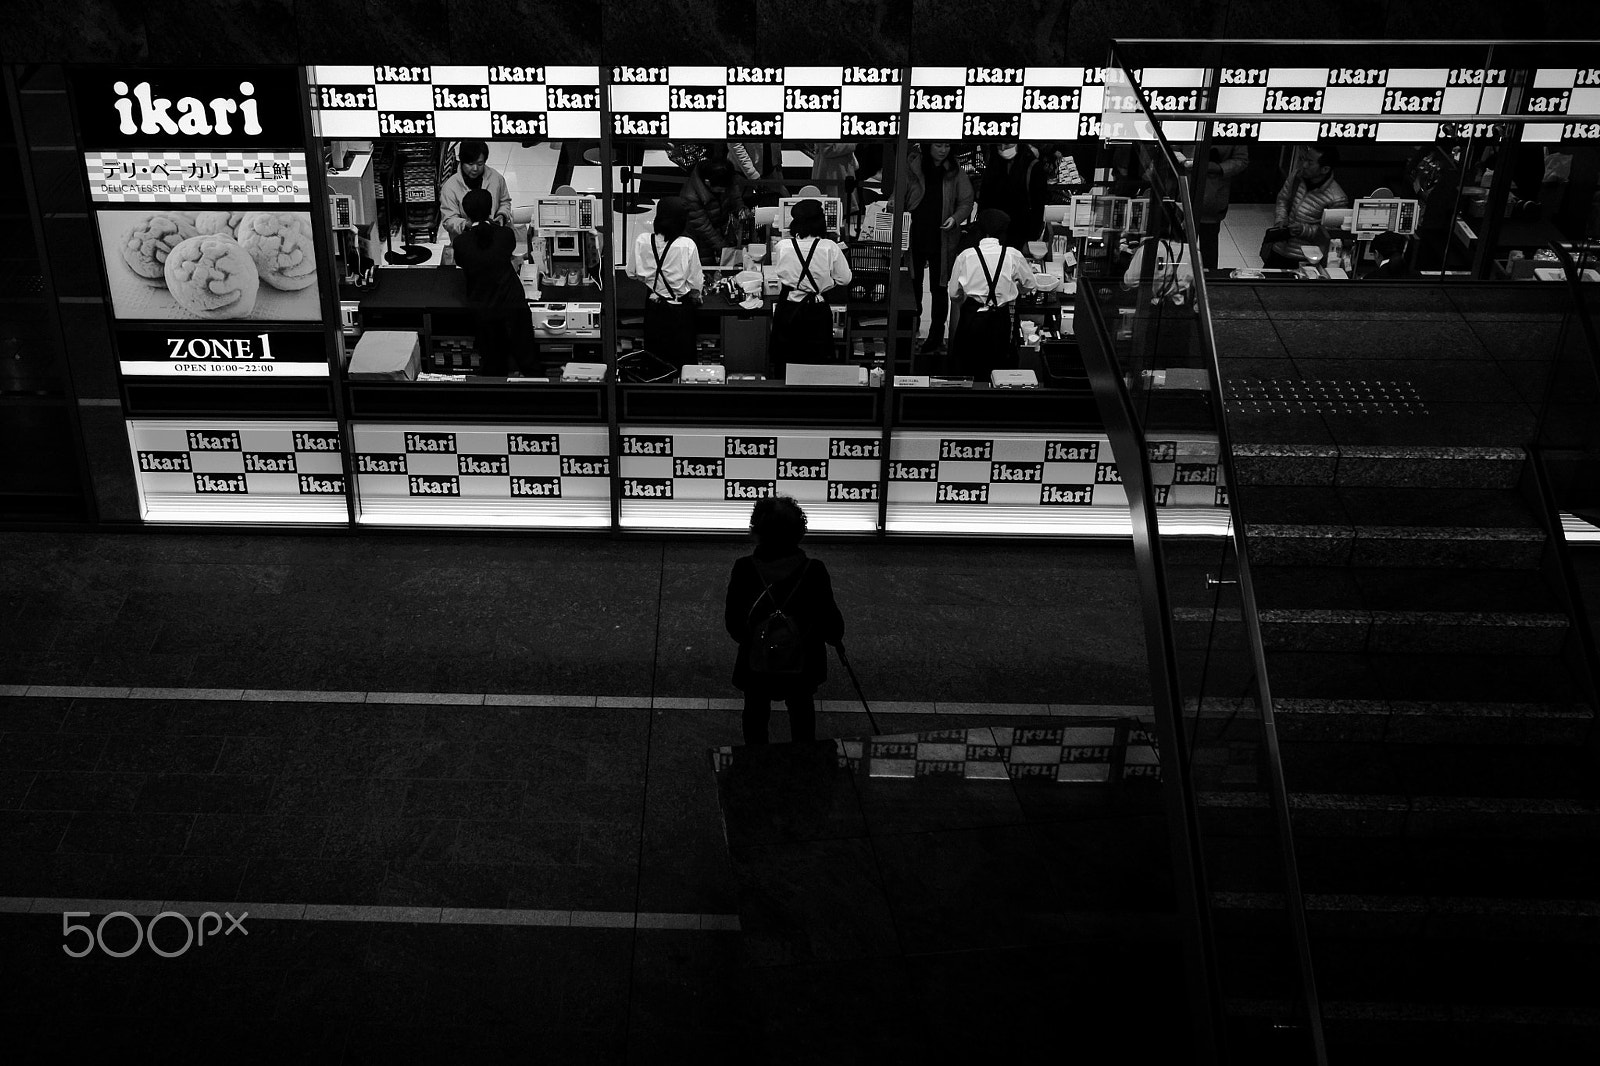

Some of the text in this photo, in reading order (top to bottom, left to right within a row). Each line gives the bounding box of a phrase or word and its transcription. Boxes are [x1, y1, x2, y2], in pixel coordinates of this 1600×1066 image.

[113, 81, 262, 135] ikari
[321, 88, 376, 108] ikari
[434, 88, 489, 109] ikari
[670, 89, 840, 109] ikari ikari
[909, 89, 1080, 110] ikari ikari
[1266, 90, 1442, 111] ikari ikari
[380, 114, 547, 135] ikari ikari
[614, 115, 897, 135] ikari ikari ikari
[964, 115, 1019, 136] ikari
[101, 184, 171, 193] DELICATESSEN
[181, 184, 218, 193] BAKERY
[229, 185, 259, 193] FRESH
[263, 185, 299, 193] FOODS
[167, 333, 276, 360] ZONE 1
[174, 363, 207, 372] OPEN
[190, 432, 240, 450] ikari
[408, 434, 558, 453] ikari ikari
[623, 437, 880, 457] ikari ikari ikari
[942, 441, 1097, 461] ikari ikari
[140, 453, 295, 471] ikari ikari
[358, 455, 610, 475] ikari ikari ikari
[675, 459, 827, 478] ikari ikari
[888, 462, 937, 480] ikari
[993, 463, 1042, 481] ikari
[197, 475, 246, 492] ikari
[411, 477, 560, 496] ikari ikari
[624, 479, 878, 500] ikari ikari ikari
[938, 484, 1092, 504] ikari ikari
